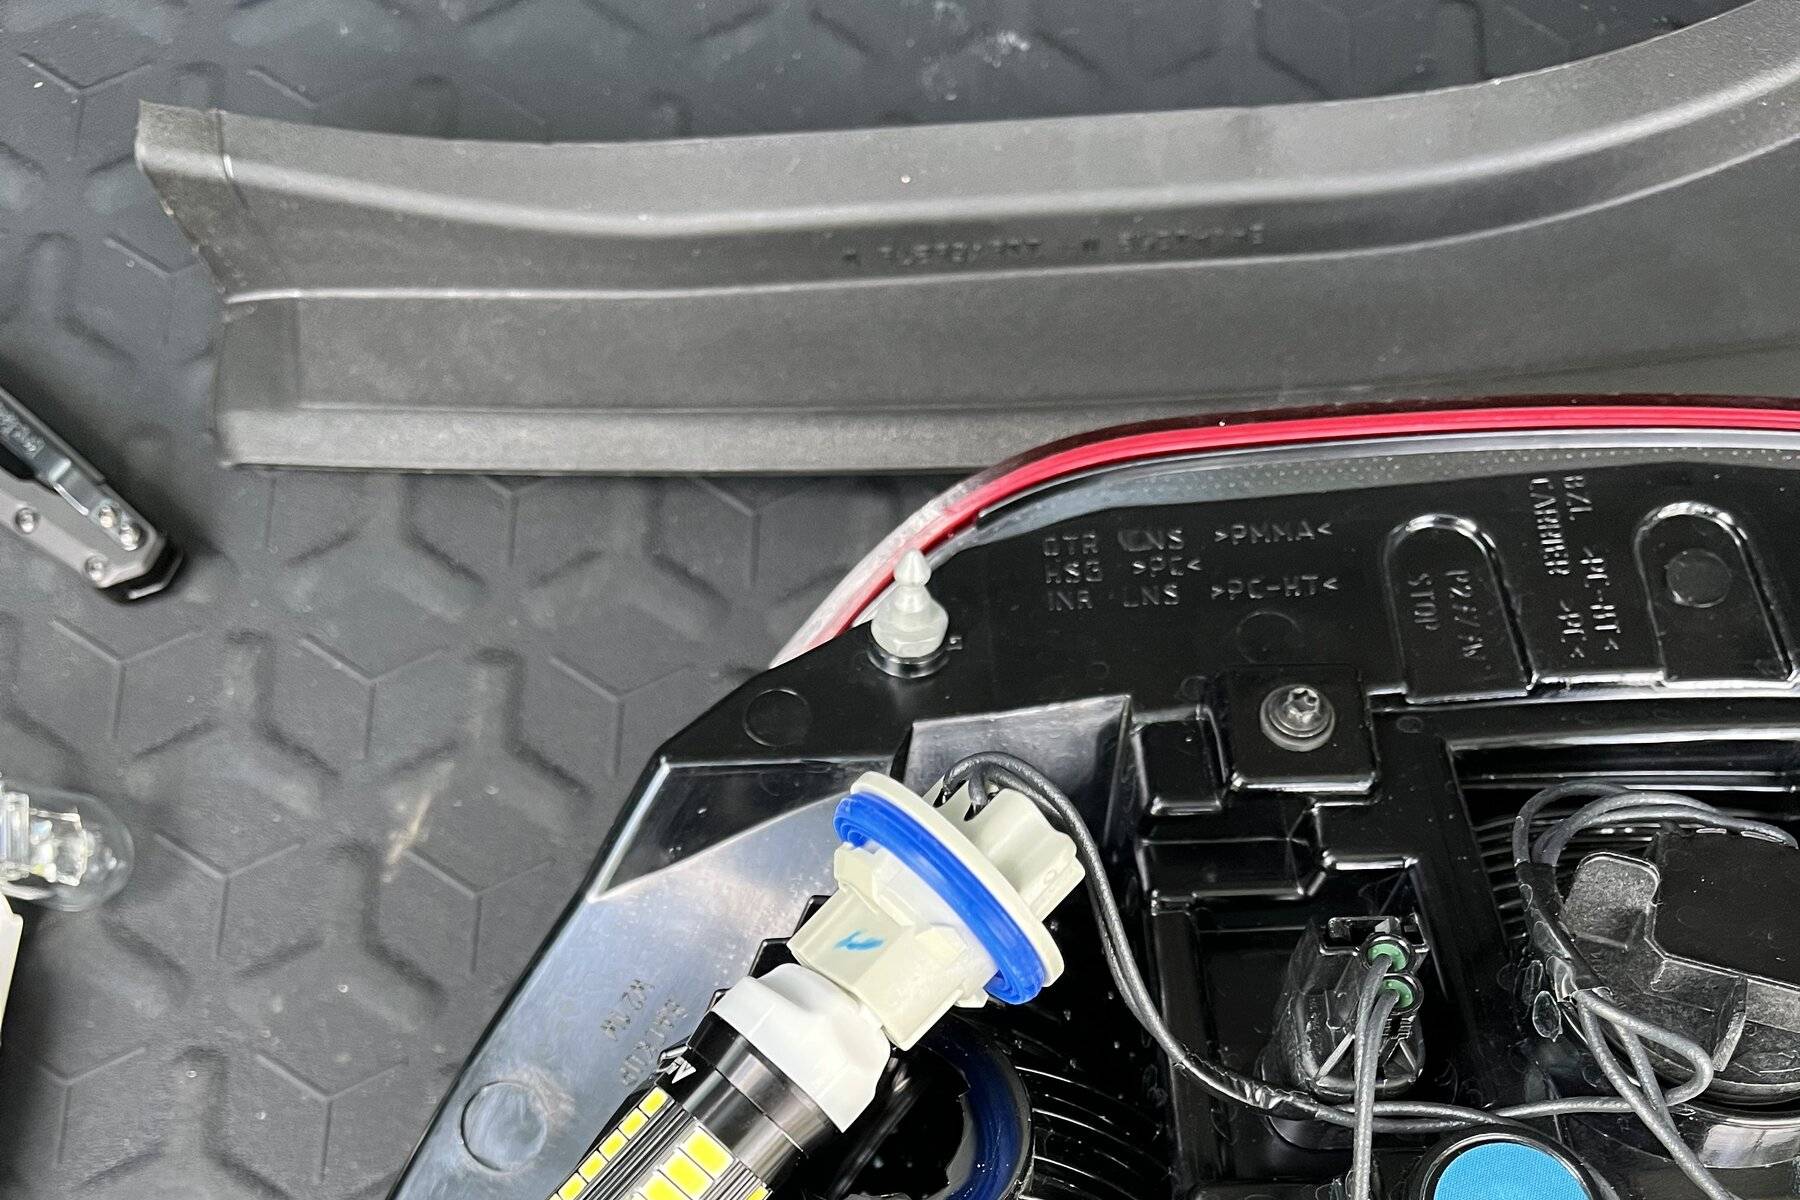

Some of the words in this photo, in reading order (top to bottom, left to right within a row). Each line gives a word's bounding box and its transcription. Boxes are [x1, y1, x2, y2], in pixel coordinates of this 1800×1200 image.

[1214, 521, 1333, 545] >PMMA<
[1132, 554, 1204, 578] >PC<
[1047, 589, 1094, 612] INR
[1122, 583, 1181, 608] LNS
[1211, 575, 1339, 600] >PC-HT<
[1409, 571, 1441, 632] STOP
